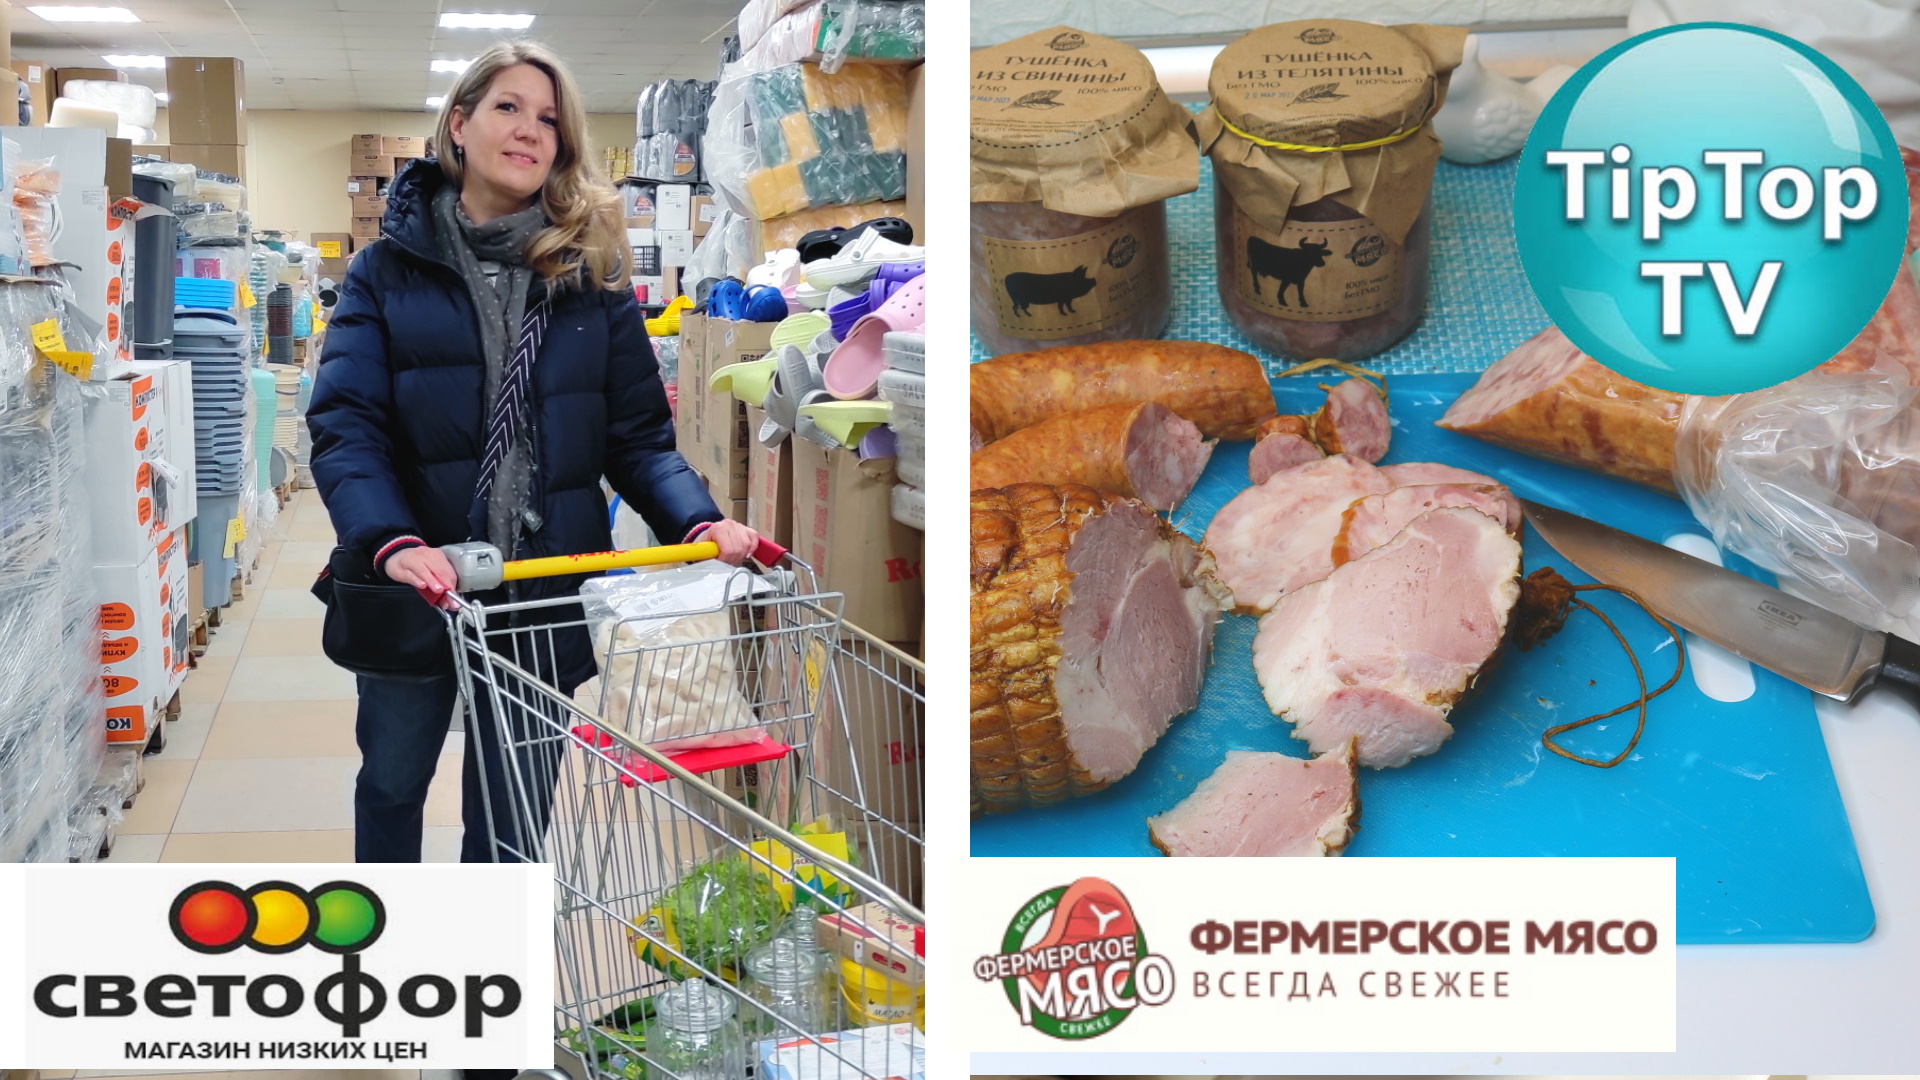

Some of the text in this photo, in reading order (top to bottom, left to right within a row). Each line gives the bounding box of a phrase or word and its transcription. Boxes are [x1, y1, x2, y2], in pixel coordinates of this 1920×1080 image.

[1004, 55, 1108, 68] ТУШЁНКА
[1261, 50, 1372, 63] ТУШЁНКА
[976, 70, 1127, 83] ИЗ СВИНИНЫ
[1238, 66, 1403, 79] ИЗ ТЕЛЯТИНЫ
[1226, 82, 1247, 90] Без
[1355, 76, 1423, 86] 100% мясо
[1077, 87, 1109, 95] 100%
[1345, 280, 1367, 290] 100%
[1345, 285, 1381, 299] Без ГМО
[1764, 604, 1797, 621] IKEA
